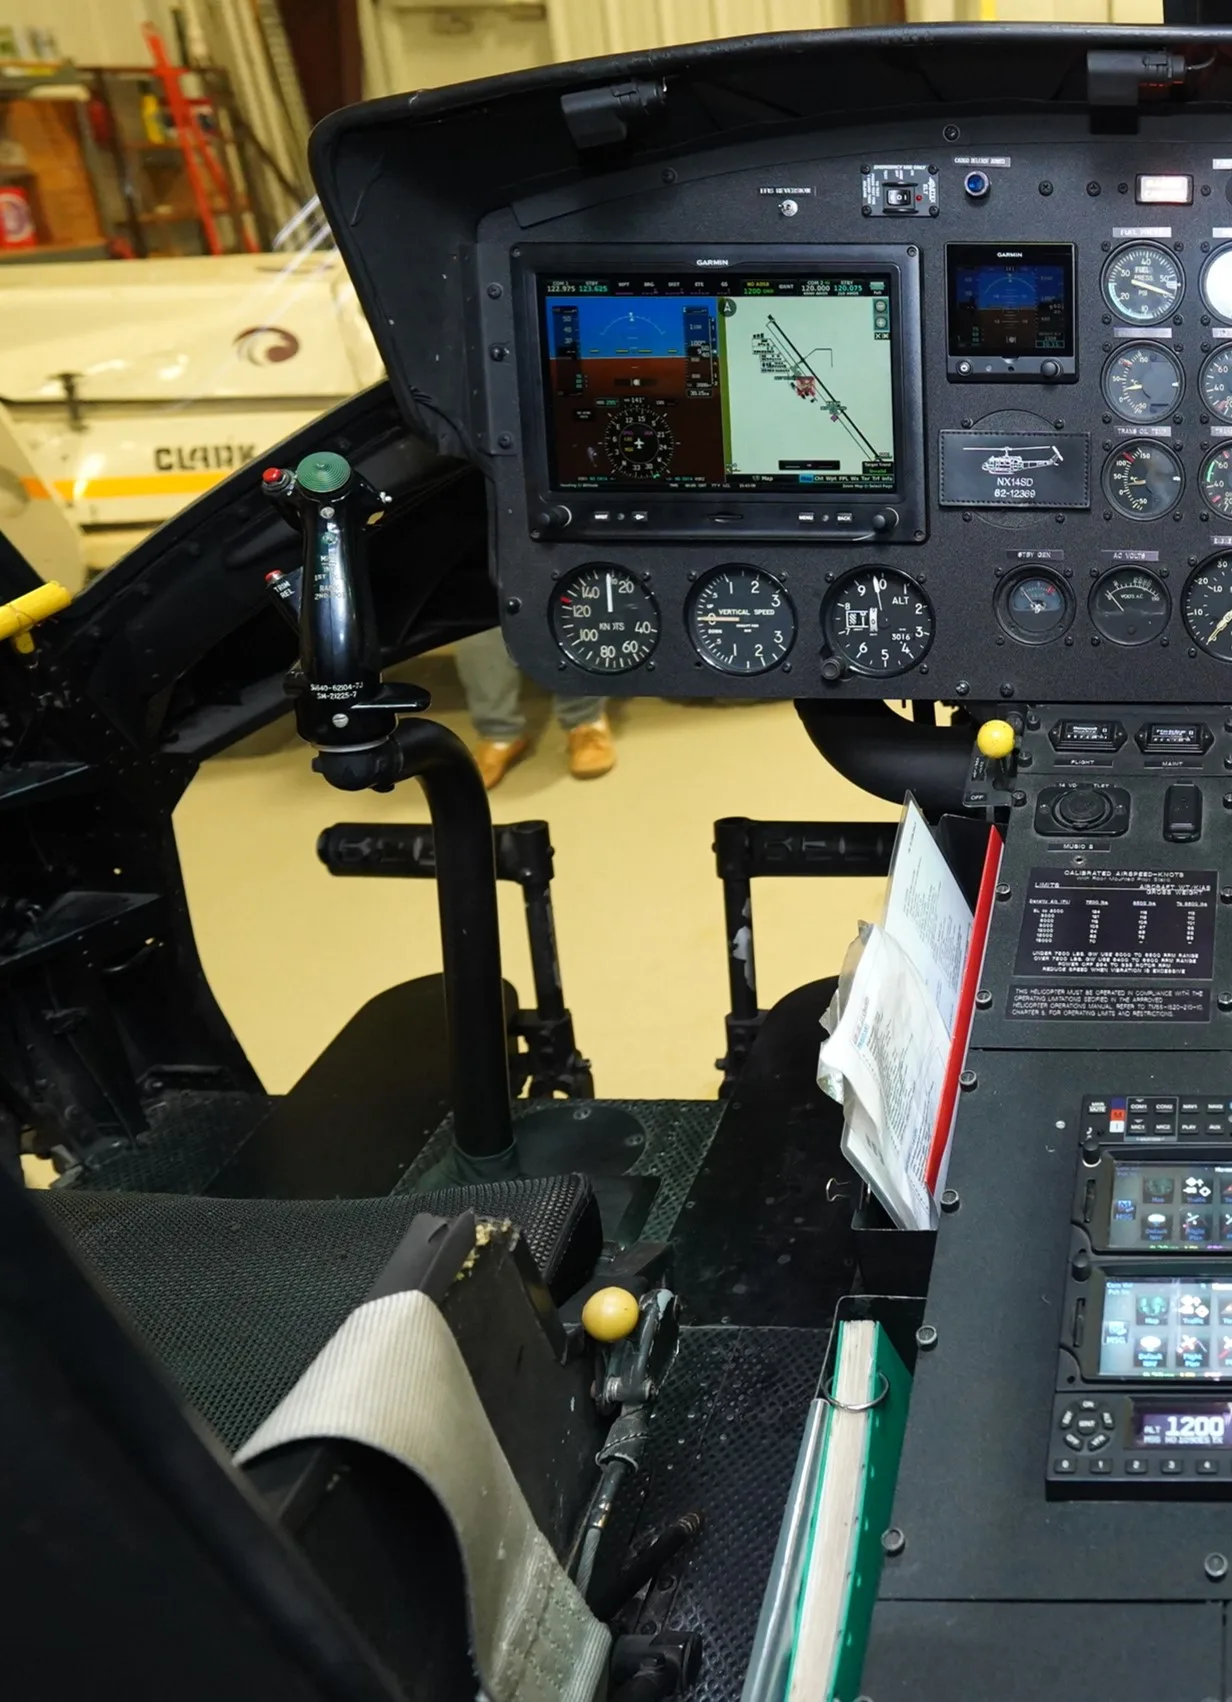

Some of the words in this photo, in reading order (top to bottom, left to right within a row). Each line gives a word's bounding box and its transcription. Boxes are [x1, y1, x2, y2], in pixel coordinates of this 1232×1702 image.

[154, 443, 256, 471] CLARK
[997, 477, 1034, 487] NX14SD
[273, 581, 291, 593] TRIM
[581, 586, 600, 599] 140
[280, 589, 296, 599] REL
[892, 596, 909, 605] ALT
[573, 605, 591, 617] 120
[635, 621, 651, 634] 40
[580, 629, 598, 641] 100
[891, 633, 911, 641] 3016
[600, 645, 616, 658] 80
[621, 640, 638, 653] 60
[1144, 1425, 1161, 1434] ALT
[1165, 1415, 1225, 1437] 1200
